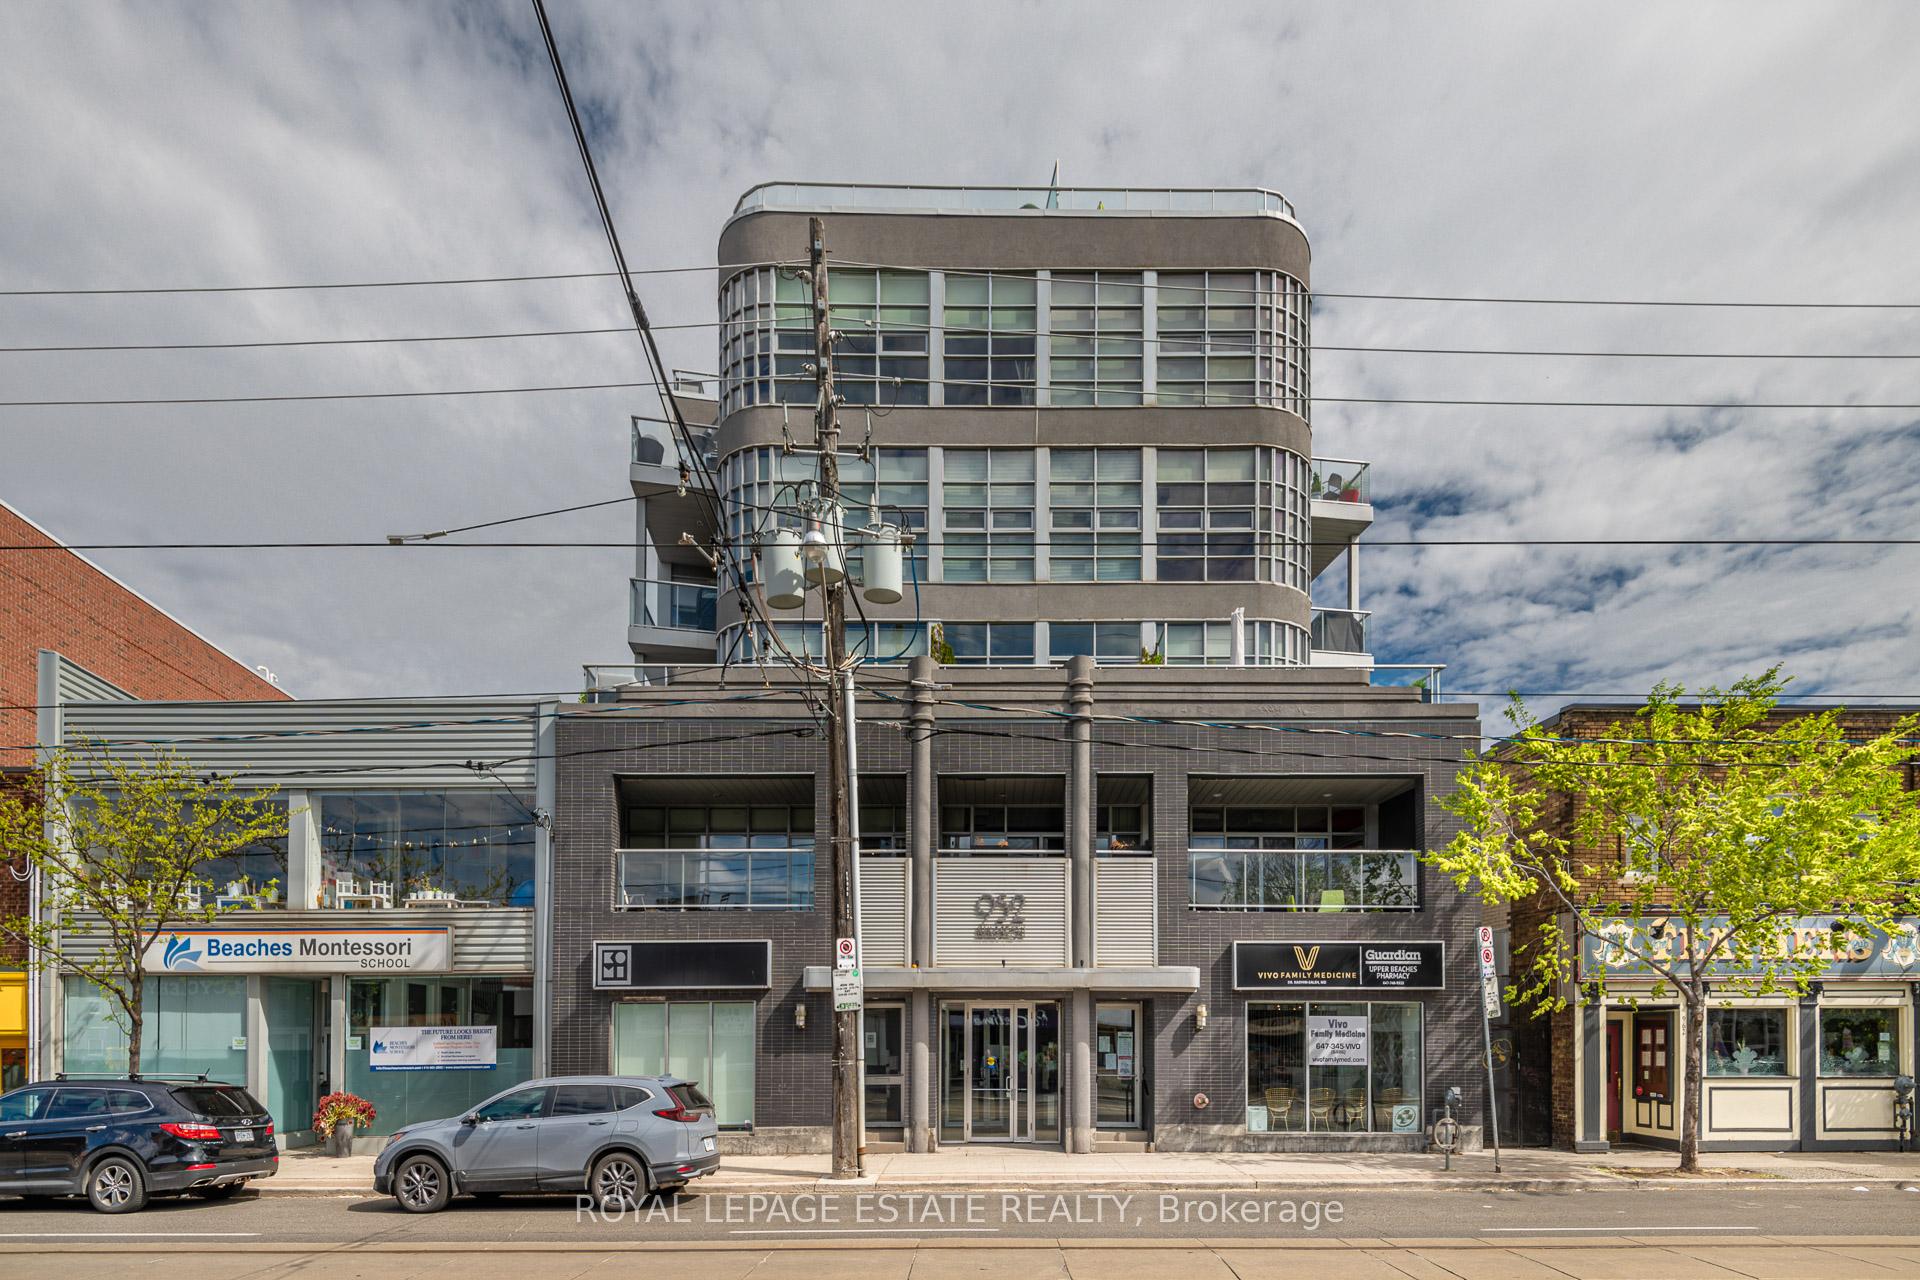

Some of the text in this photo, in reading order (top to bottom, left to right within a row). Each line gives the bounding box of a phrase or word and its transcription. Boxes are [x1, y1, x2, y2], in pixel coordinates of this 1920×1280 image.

[208, 938, 411, 956] Beaches Montessori
[1365, 949, 1421, 960] Guardian
[360, 958, 410, 968] SCHOOL
[1328, 1019, 1347, 1028] Vivo
[1311, 1030, 1365, 1039] Family Medicine
